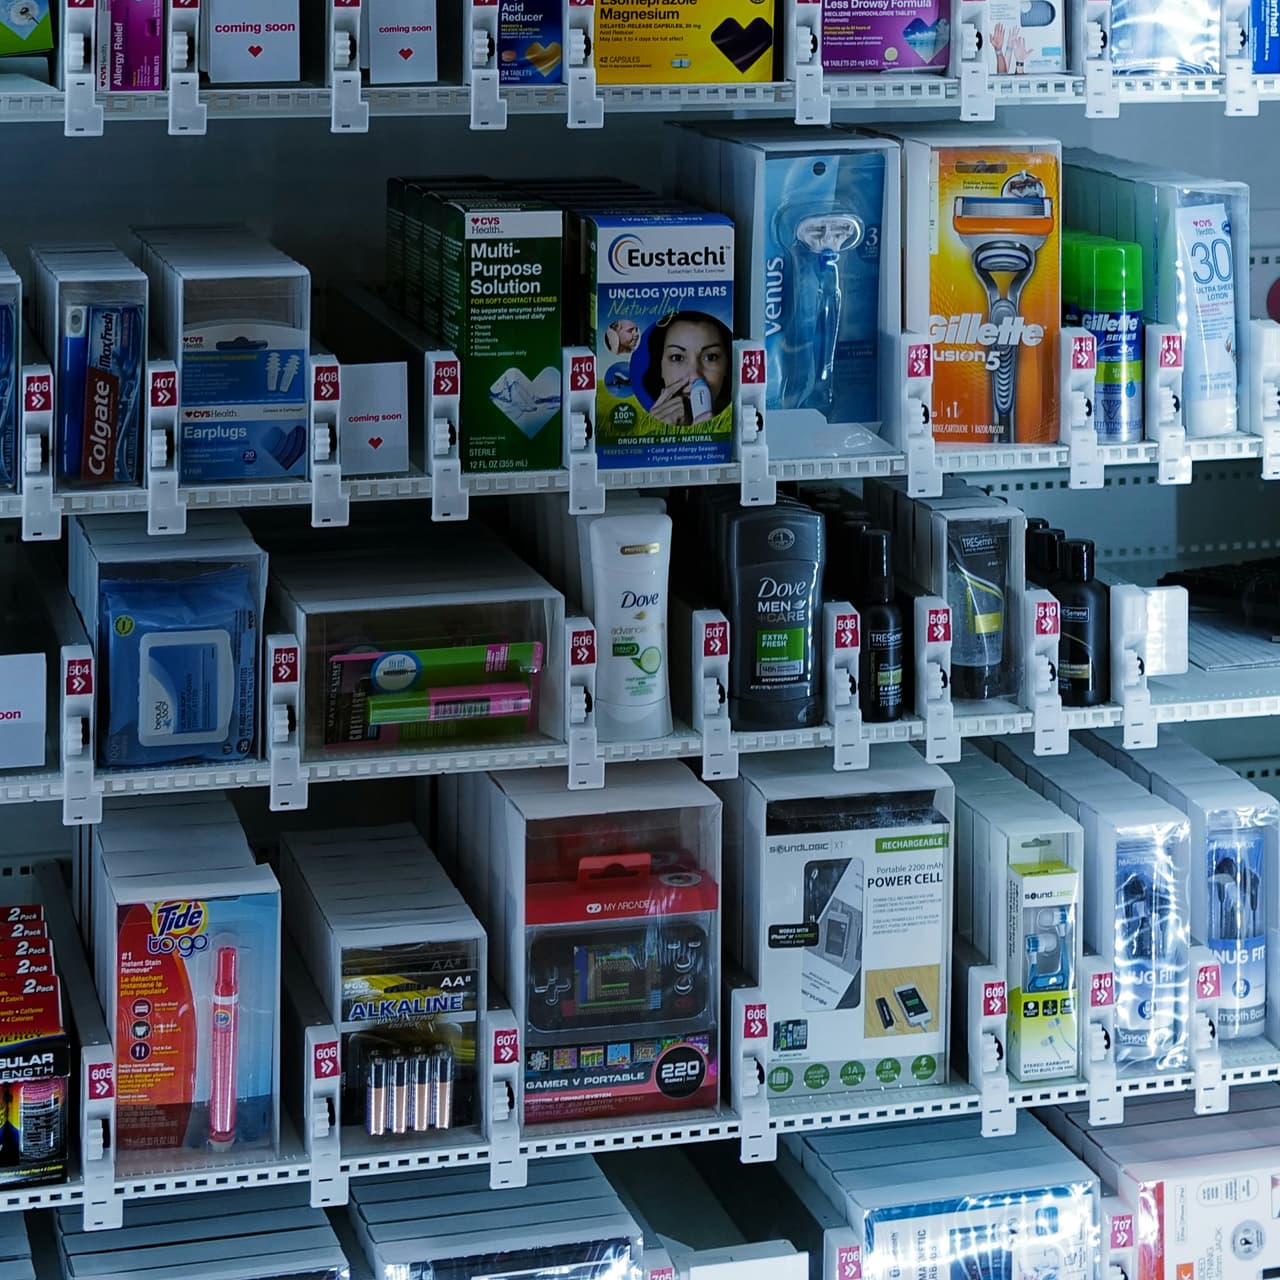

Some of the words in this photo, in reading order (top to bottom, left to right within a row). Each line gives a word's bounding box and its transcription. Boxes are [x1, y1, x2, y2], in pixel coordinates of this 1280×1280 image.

[501, 2, 524, 12] Acid
[825, 0, 848, 8] Less
[501, 12, 543, 21] Reducer
[600, 8, 679, 21] Magnesium
[471, 243, 520, 258] Multi-
[628, 246, 726, 268] Eustachi
[470, 263, 542, 278] Purpose
[470, 280, 541, 294] Solution
[609, 288, 659, 299] UNCLOG
[662, 288, 694, 298] YOUR
[697, 286, 726, 297] EARS
[471, 297, 483, 305] FOR
[503, 296, 529, 304] CONTACT
[531, 296, 557, 304] LENSES
[766, 257, 783, 337] venus
[911, 349, 929, 360] 412
[573, 362, 593, 372] 410
[154, 378, 174, 389] 407
[184, 425, 246, 439] Earplugs
[758, 578, 806, 598] Dove
[621, 591, 659, 609] Dove
[758, 601, 791, 612] MEN
[930, 615, 948, 624] 509
[706, 628, 724, 638] 507
[275, 654, 295, 663] 505
[68, 665, 89, 676] 504
[881, 837, 942, 850] RECHARGEABLE
[876, 865, 906, 874] Portable
[907, 863, 923, 872] 2200
[924, 862, 943, 871] mAh
[867, 874, 911, 888] POWER
[914, 872, 942, 885] CELL
[159, 905, 203, 935] Tide
[148, 936, 174, 952] to
[178, 933, 207, 956] go
[1199, 971, 1217, 981] 611
[24, 980, 35, 993] 2
[36, 983, 54, 993] Pack
[349, 995, 464, 1021] ALKALINE
[747, 1008, 766, 1019] 608
[316, 1048, 337, 1060] 606
[661, 1060, 700, 1077] 220
[526, 1080, 568, 1090] GAMER
[573, 1078, 581, 1087] V
[584, 1072, 645, 1086] PORTABLE
[1113, 1220, 1131, 1230] 707
